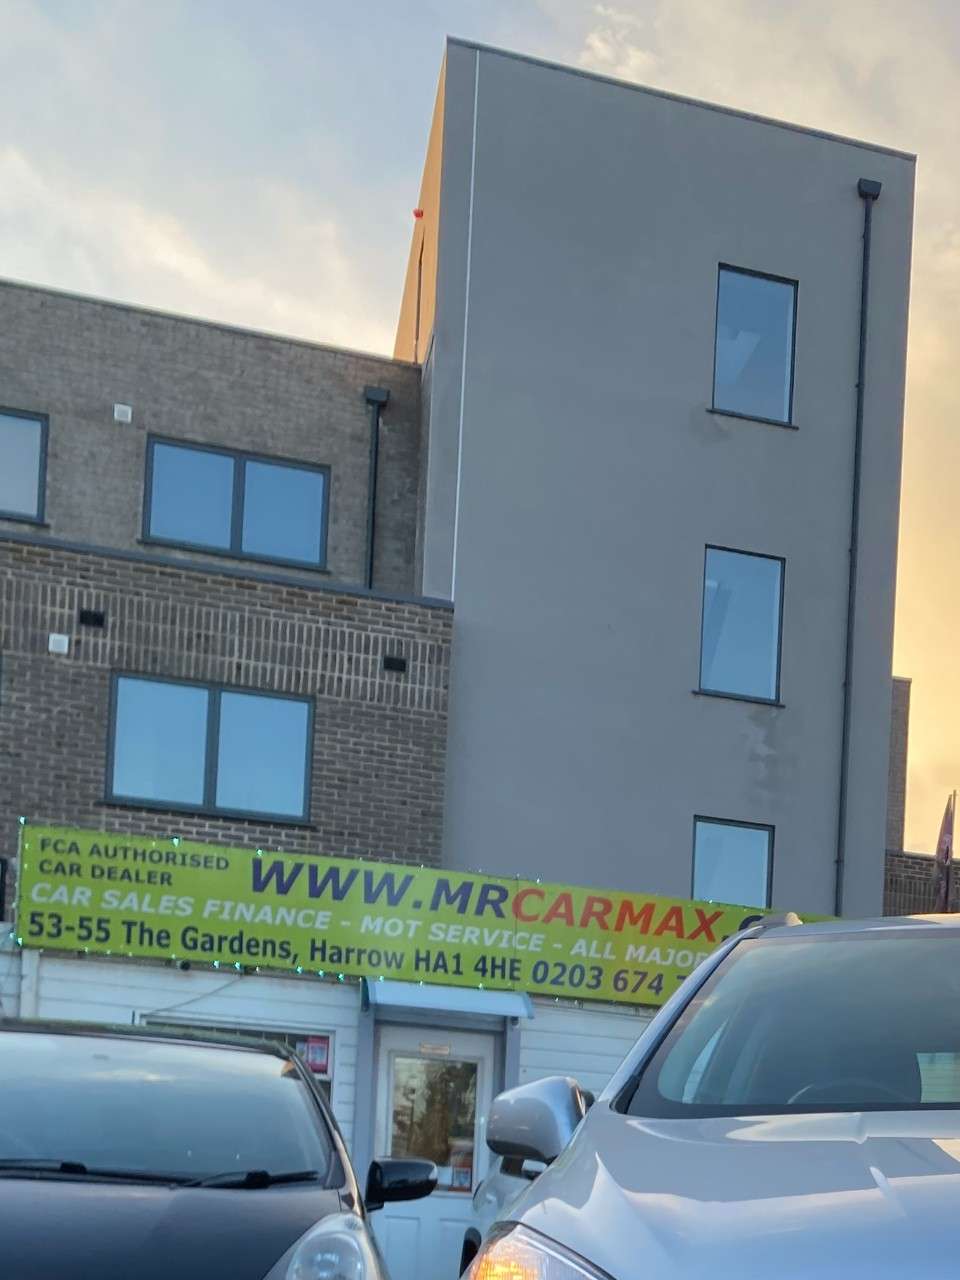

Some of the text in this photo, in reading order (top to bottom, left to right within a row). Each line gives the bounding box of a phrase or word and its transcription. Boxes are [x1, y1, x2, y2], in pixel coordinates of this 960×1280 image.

[39, 838, 229, 871] FCA AUTHORISED
[39, 859, 173, 887] CAR DEALER
[31, 882, 91, 909] CAR
[101, 889, 194, 918] SALES
[202, 898, 332, 930] FINANCE
[360, 915, 422, 940] MOT
[428, 921, 545, 952] SERVICE
[570, 938, 616, 961] ALL
[28, 911, 664, 995] 53-55 The Gardens, Harrow HA1 4HE 0203 674
